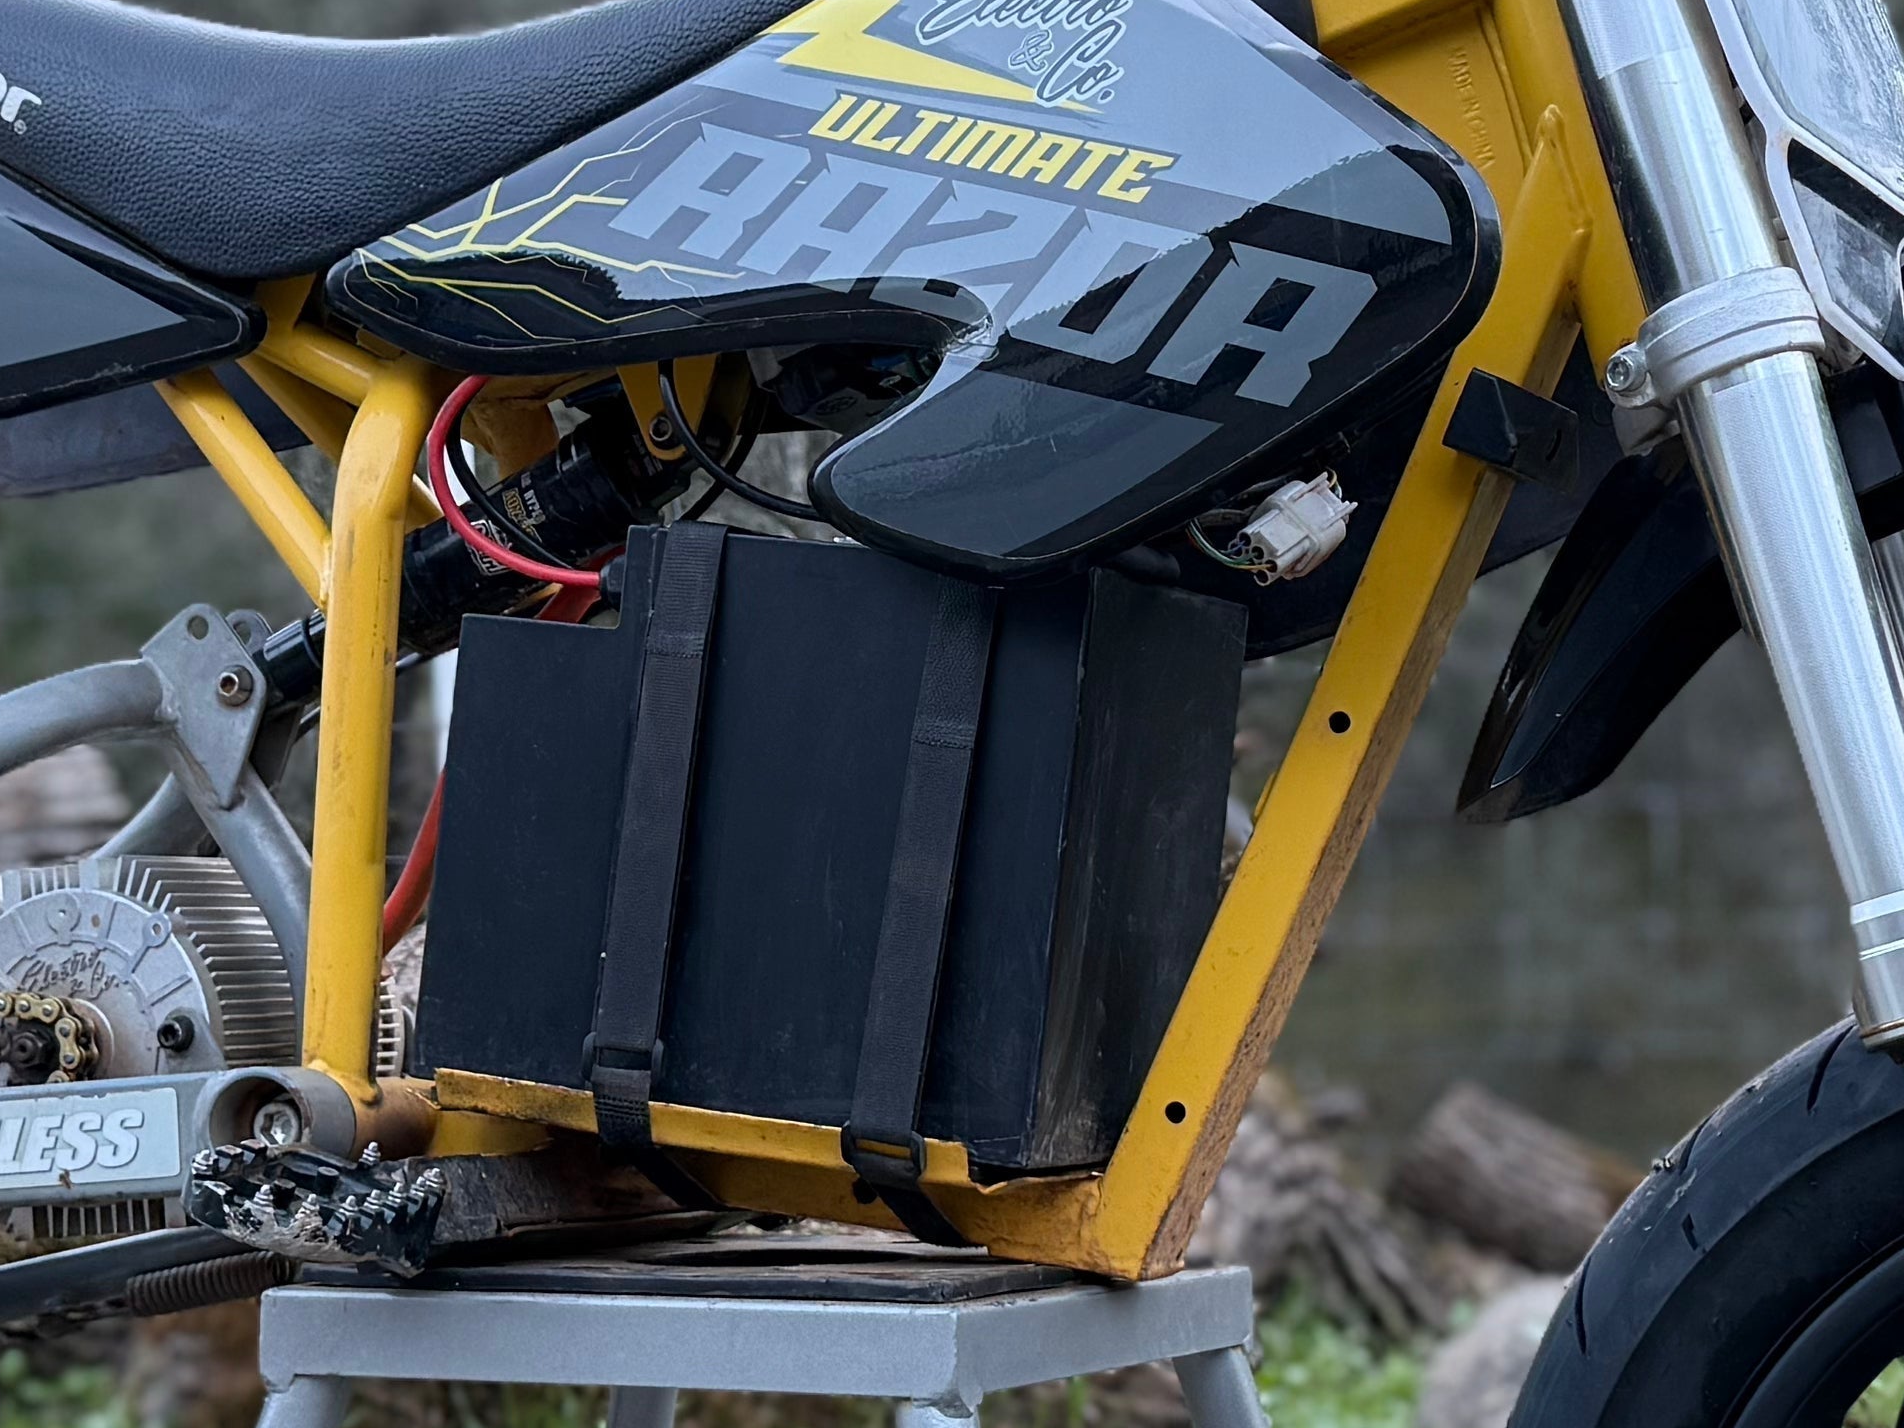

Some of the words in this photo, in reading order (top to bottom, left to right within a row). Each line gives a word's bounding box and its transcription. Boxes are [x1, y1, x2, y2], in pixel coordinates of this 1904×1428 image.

[1009, 29, 1053, 69] &
[1033, 16, 1125, 108] Co.
[808, 90, 1181, 203] ULTIMATE
[1467, 118, 1496, 170] CHINA
[609, 123, 1378, 408] RAZOR
